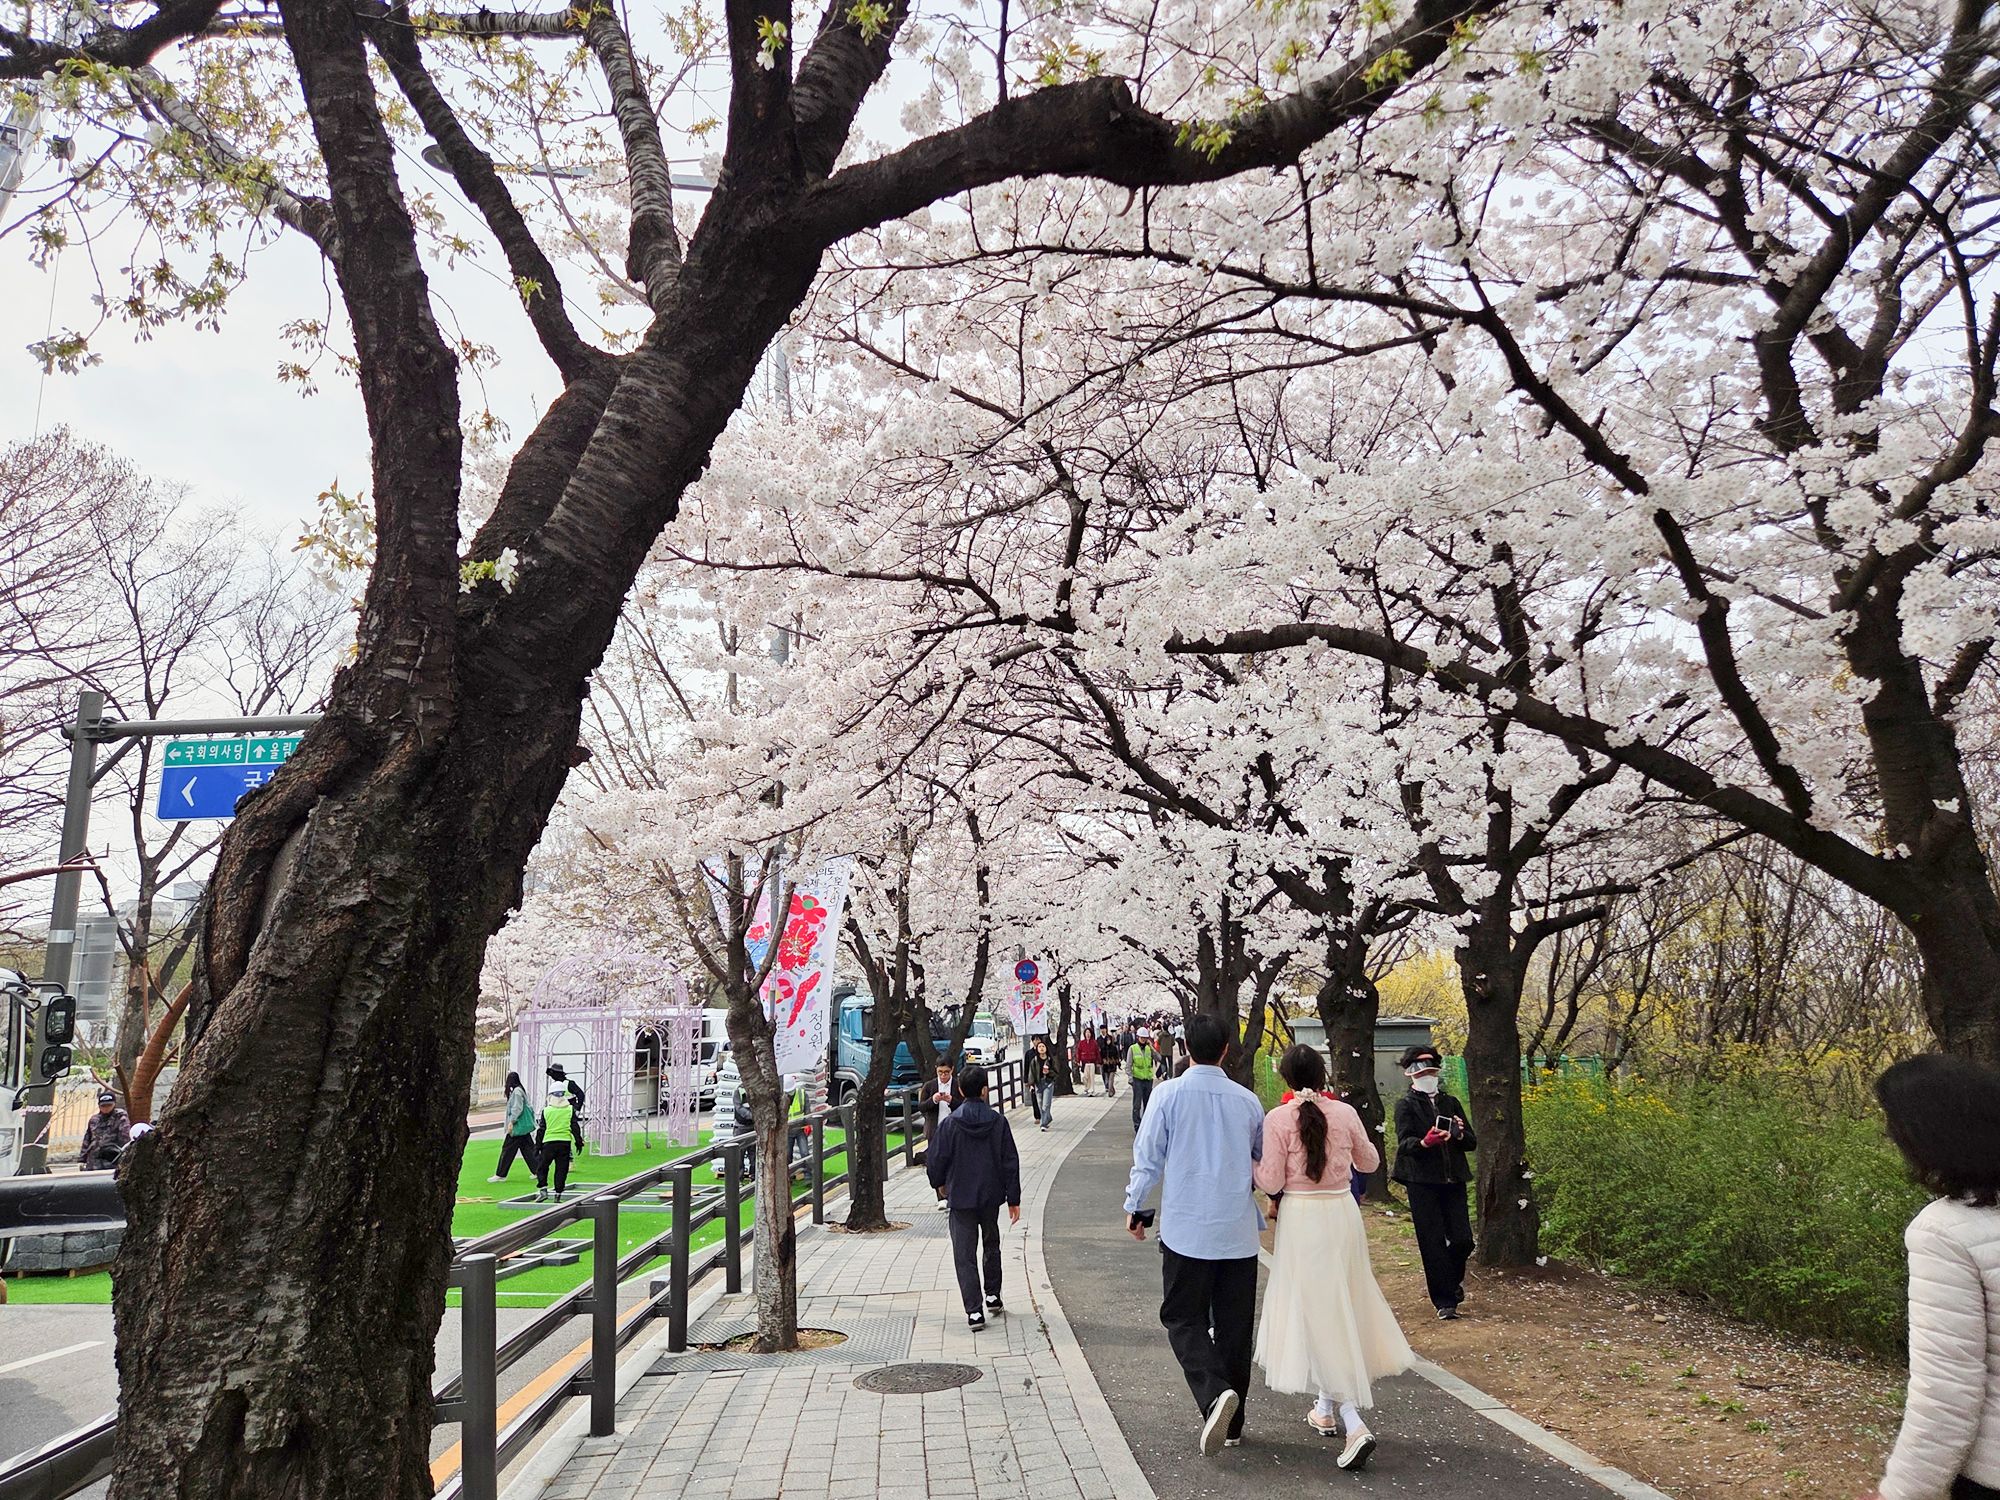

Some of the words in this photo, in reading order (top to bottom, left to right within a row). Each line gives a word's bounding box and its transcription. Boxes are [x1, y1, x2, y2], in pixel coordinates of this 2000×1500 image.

[185, 744, 244, 761] 국회의사당
[269, 741, 299, 760] 올림
[743, 869, 763, 878] 202
[809, 1009, 822, 1050] 정원
